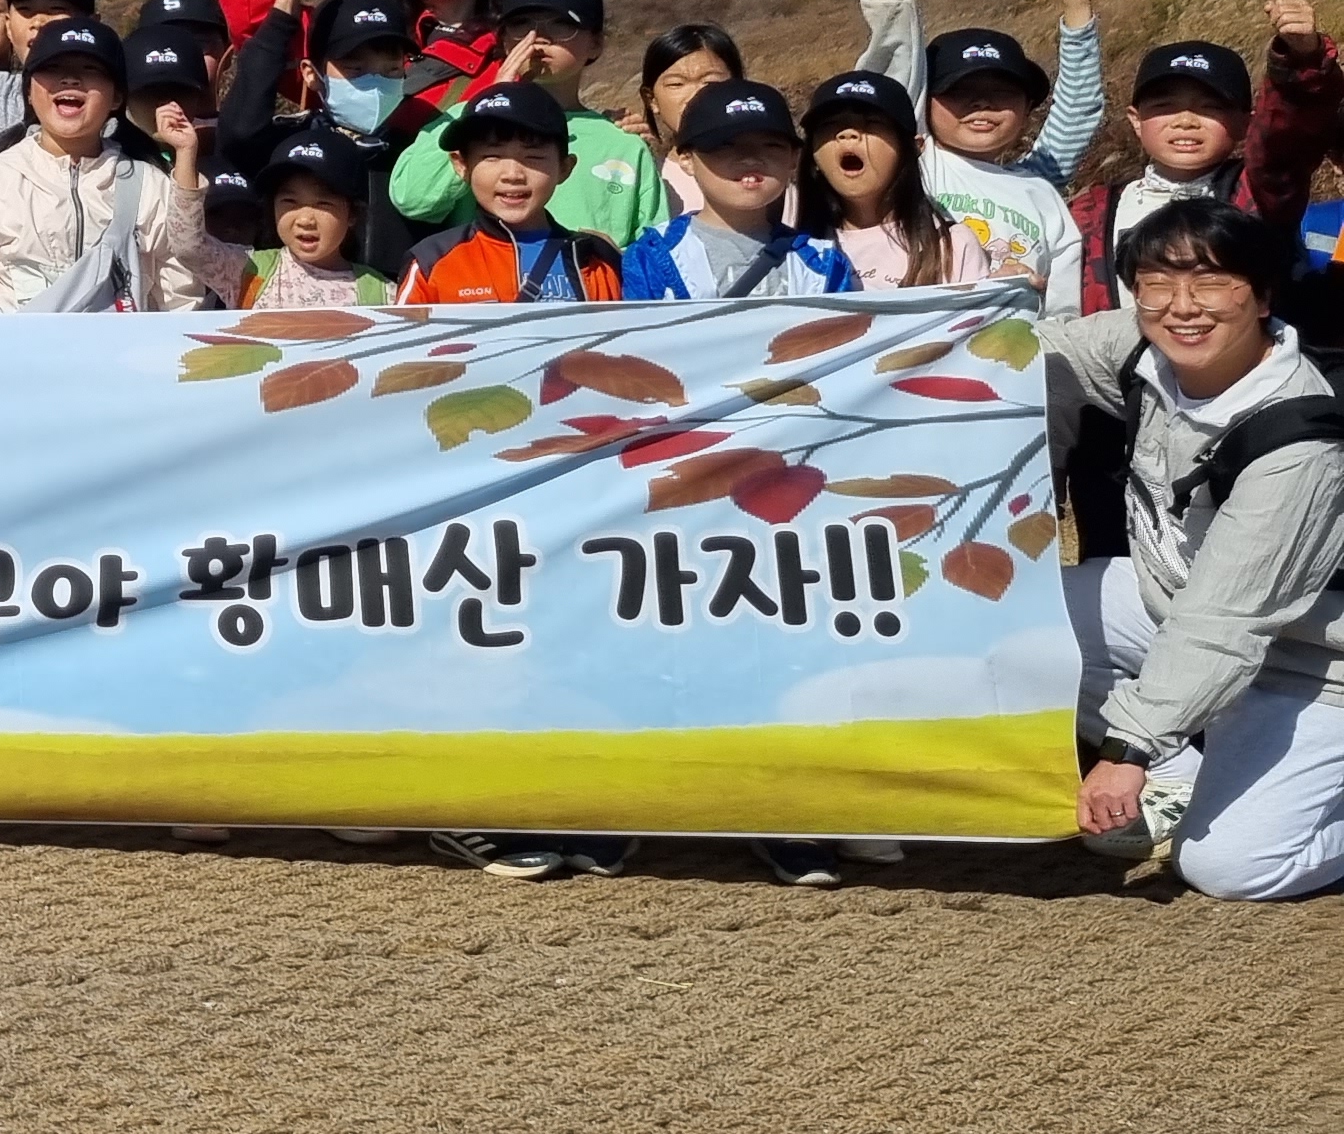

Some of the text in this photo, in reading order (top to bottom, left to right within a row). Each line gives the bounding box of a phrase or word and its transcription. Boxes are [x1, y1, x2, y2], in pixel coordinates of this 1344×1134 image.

[458, 287, 492, 297] KOLON
[178, 519, 537, 648] 황매산
[581, 523, 902, 638] 가자!!
